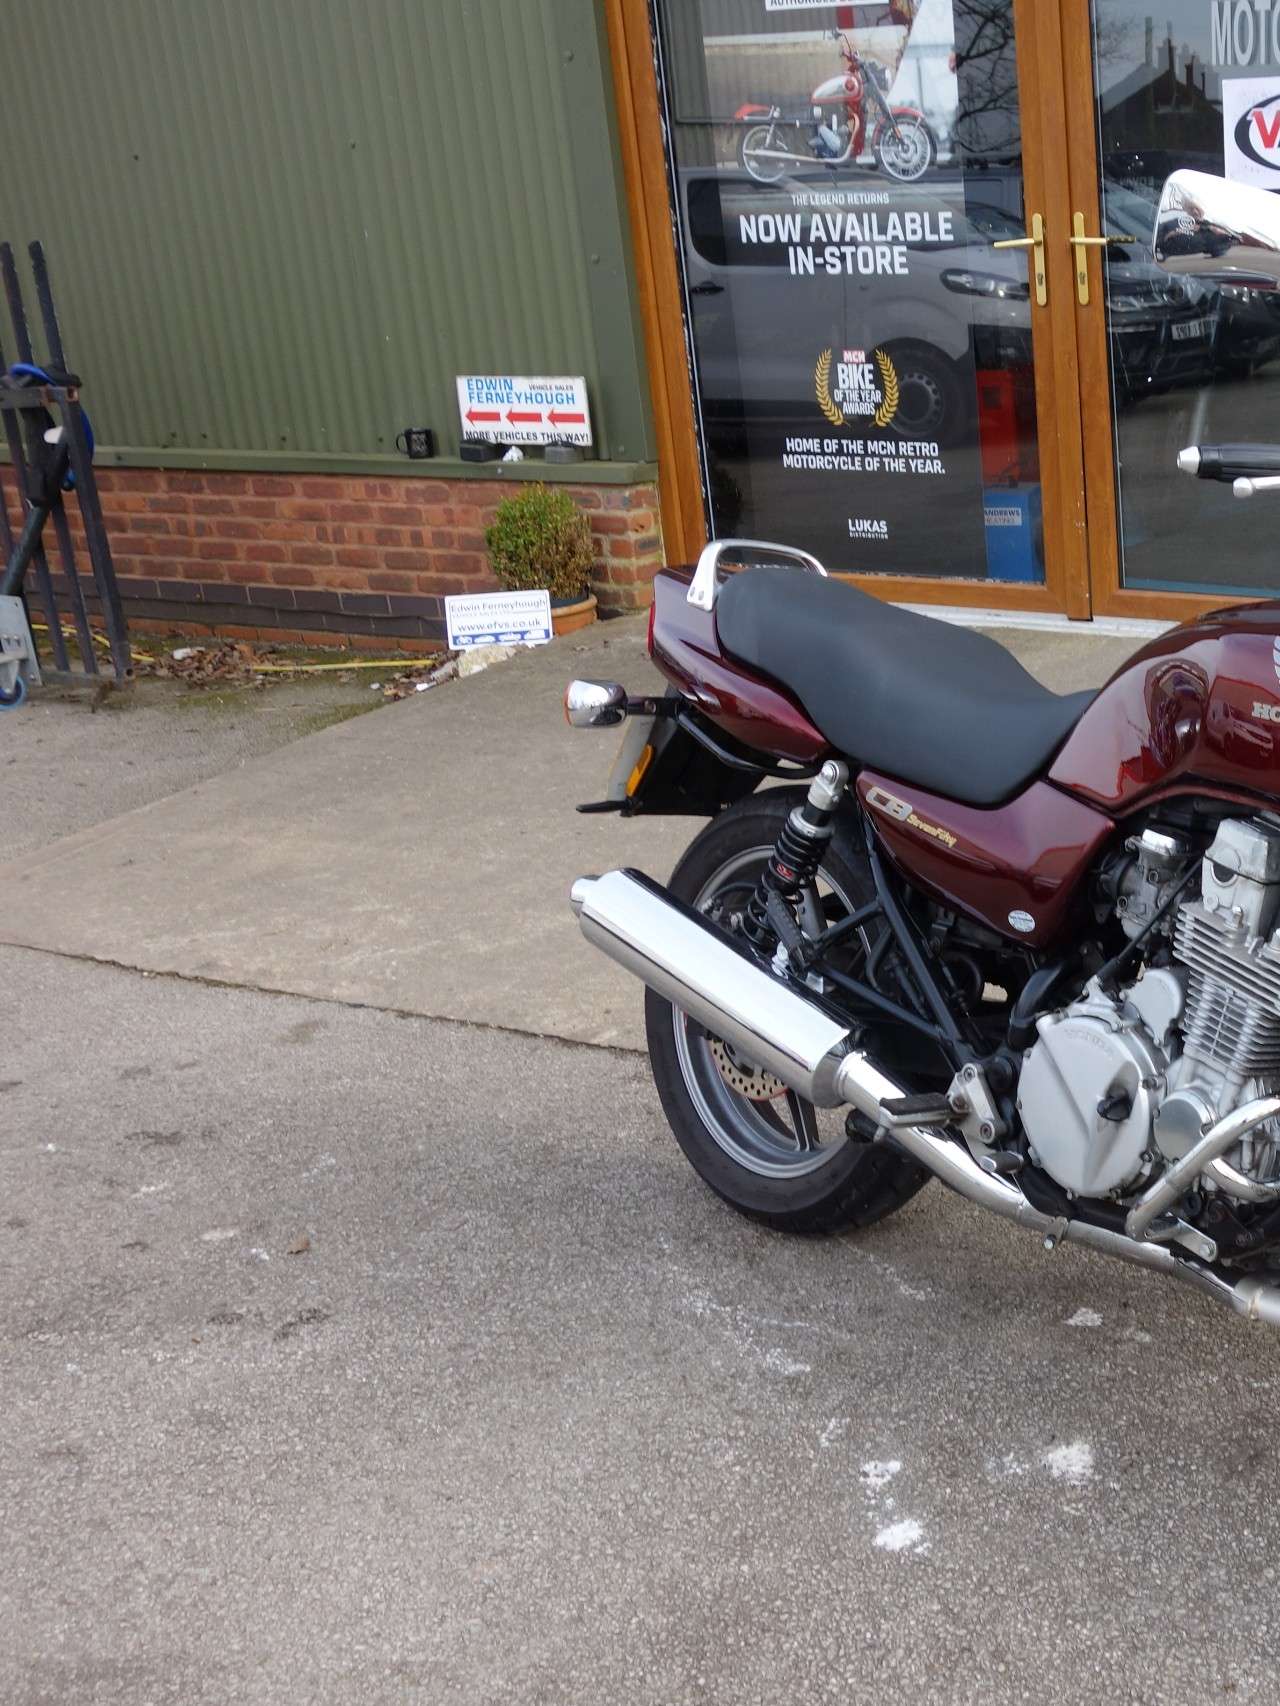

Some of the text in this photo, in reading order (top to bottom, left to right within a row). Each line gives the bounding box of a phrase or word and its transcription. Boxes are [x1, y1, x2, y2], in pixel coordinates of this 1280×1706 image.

[791, 191, 889, 206] THE LEGEND RETURNS
[739, 211, 954, 243] NOW AVAILABLE
[787, 245, 909, 275] IN-STORE
[843, 350, 866, 363] MCN
[836, 363, 876, 390] BIKE
[467, 378, 513, 391] EDWIN
[468, 392, 576, 405] FERNEYHOUGH
[833, 389, 882, 403] OF THE YEAR
[842, 402, 876, 415] AWARDS
[465, 431, 589, 443] MORE VEHICLES THIS WAY!
[786, 437, 939, 457] HOME OF THE MCN RETRO
[782, 454, 946, 474] MOTORCYCLE OF THE YEAR.
[848, 518, 887, 533] LUKAS
[865, 786, 913, 822] CB
